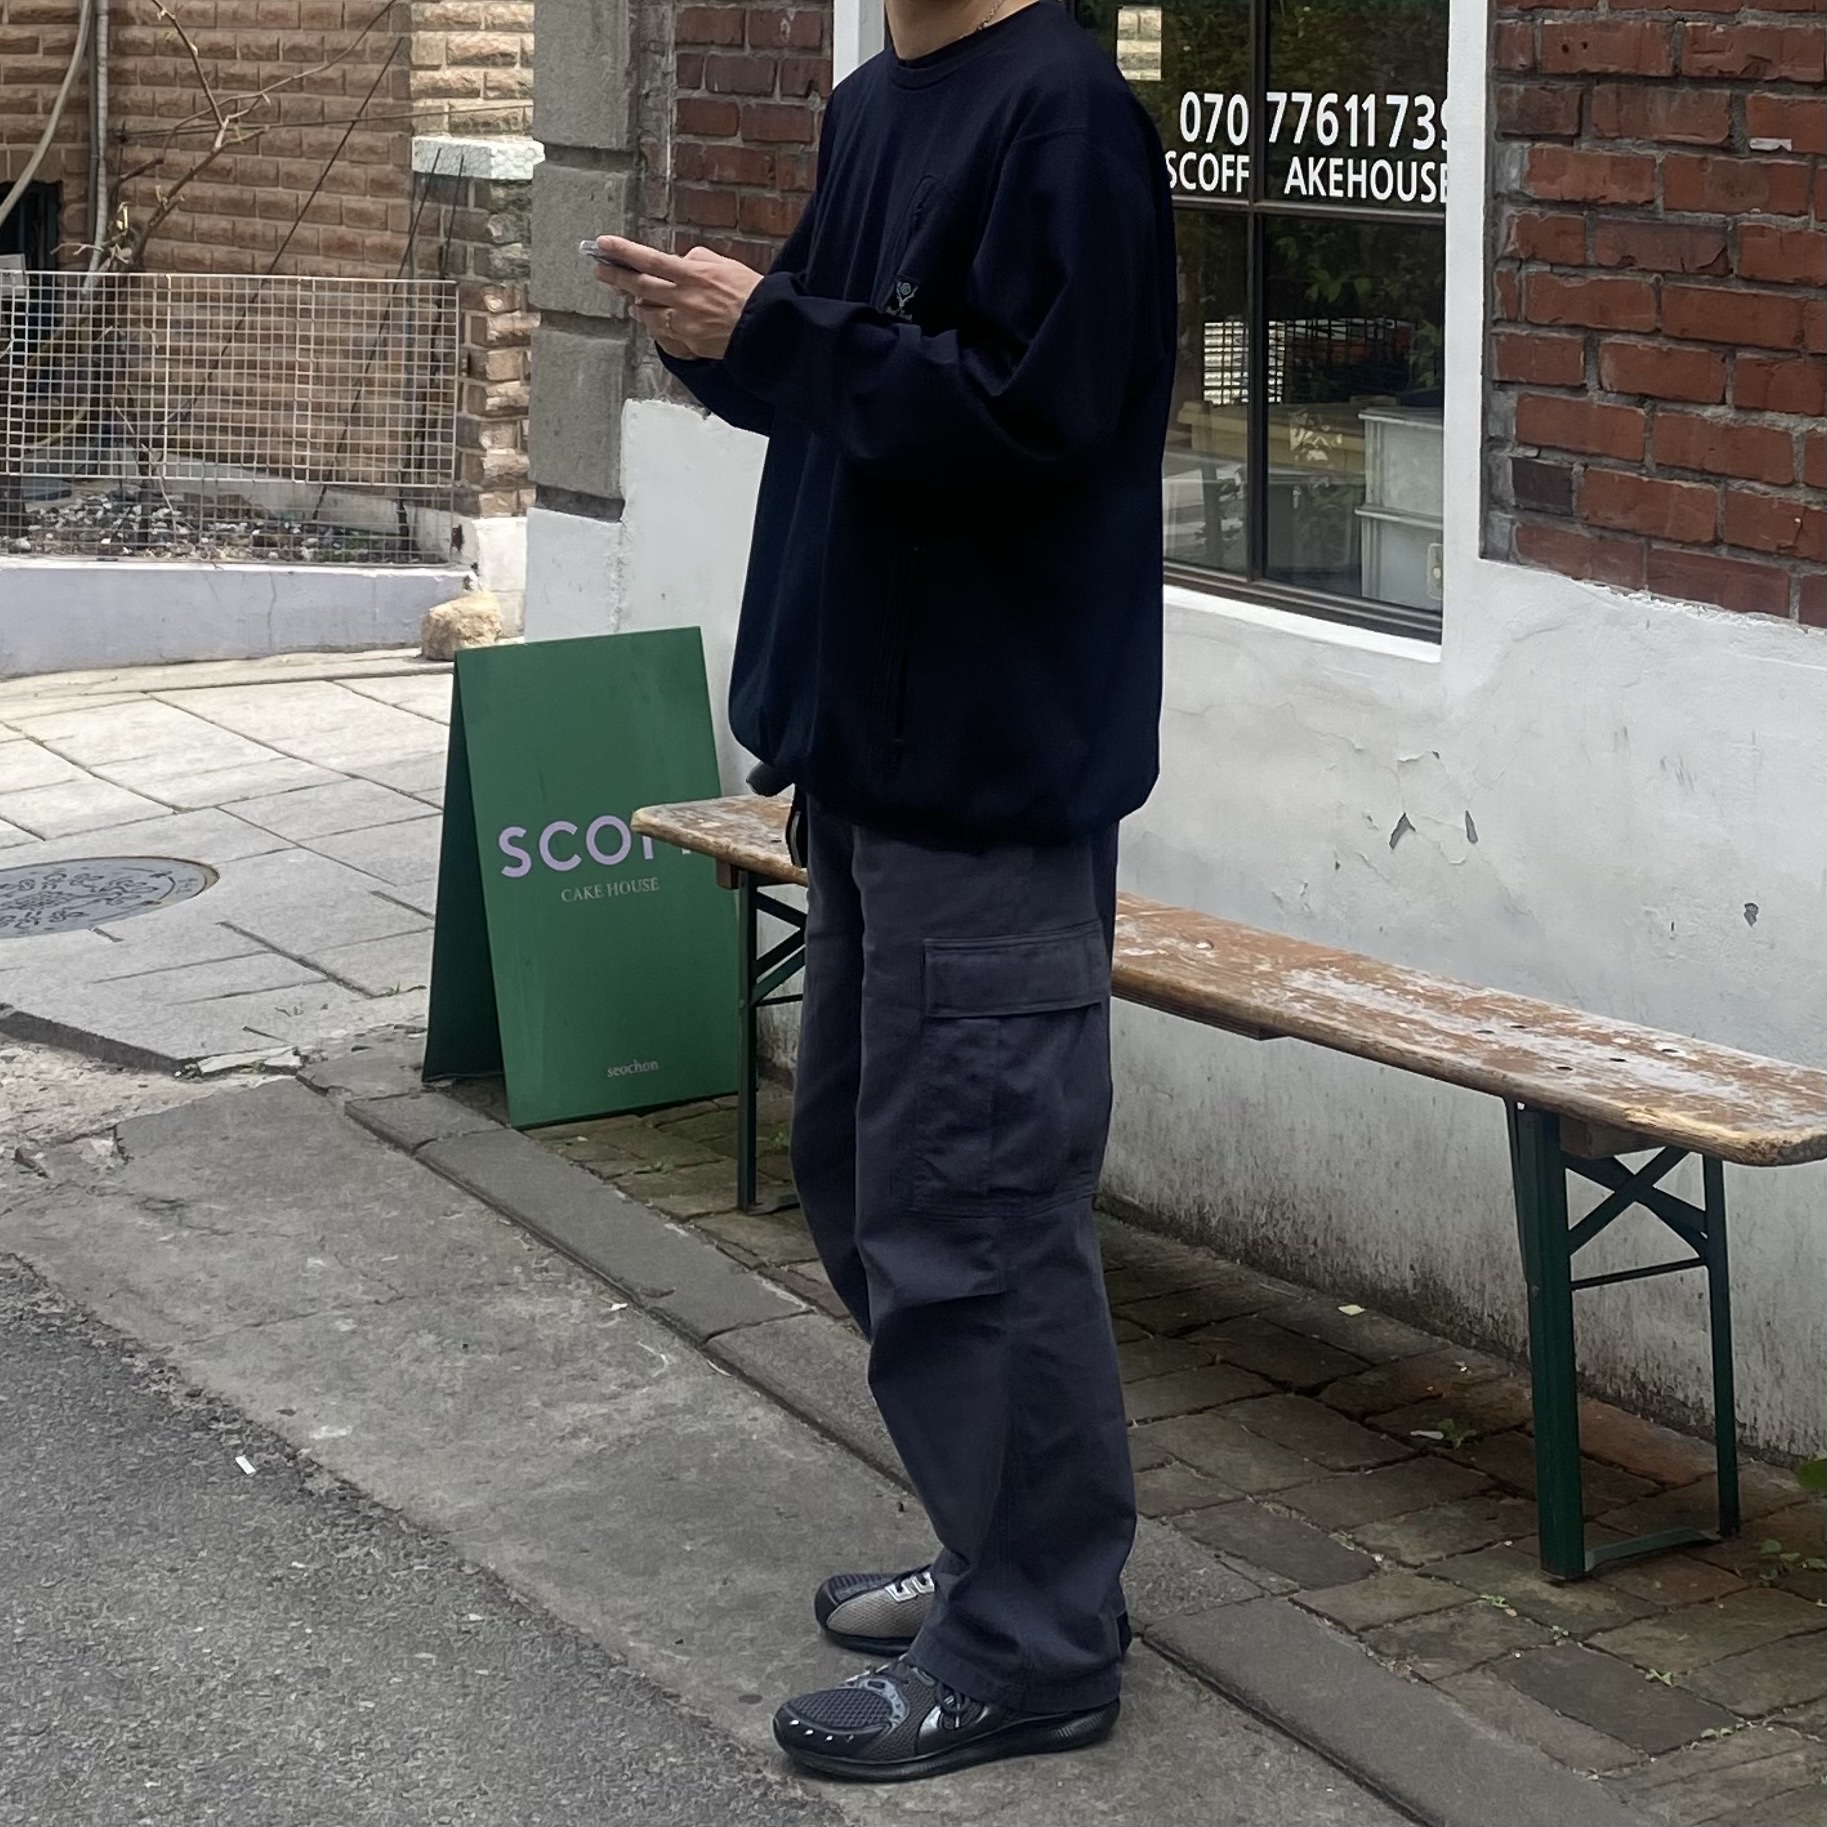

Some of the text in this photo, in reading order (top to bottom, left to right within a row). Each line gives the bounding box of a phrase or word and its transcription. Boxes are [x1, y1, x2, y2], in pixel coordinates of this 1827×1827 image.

[1180, 91, 1249, 146] 070
[1164, 150, 1250, 193] SCOFF
[560, 876, 660, 903] CAKE HOUSE
[607, 1059, 659, 1078] seochon
